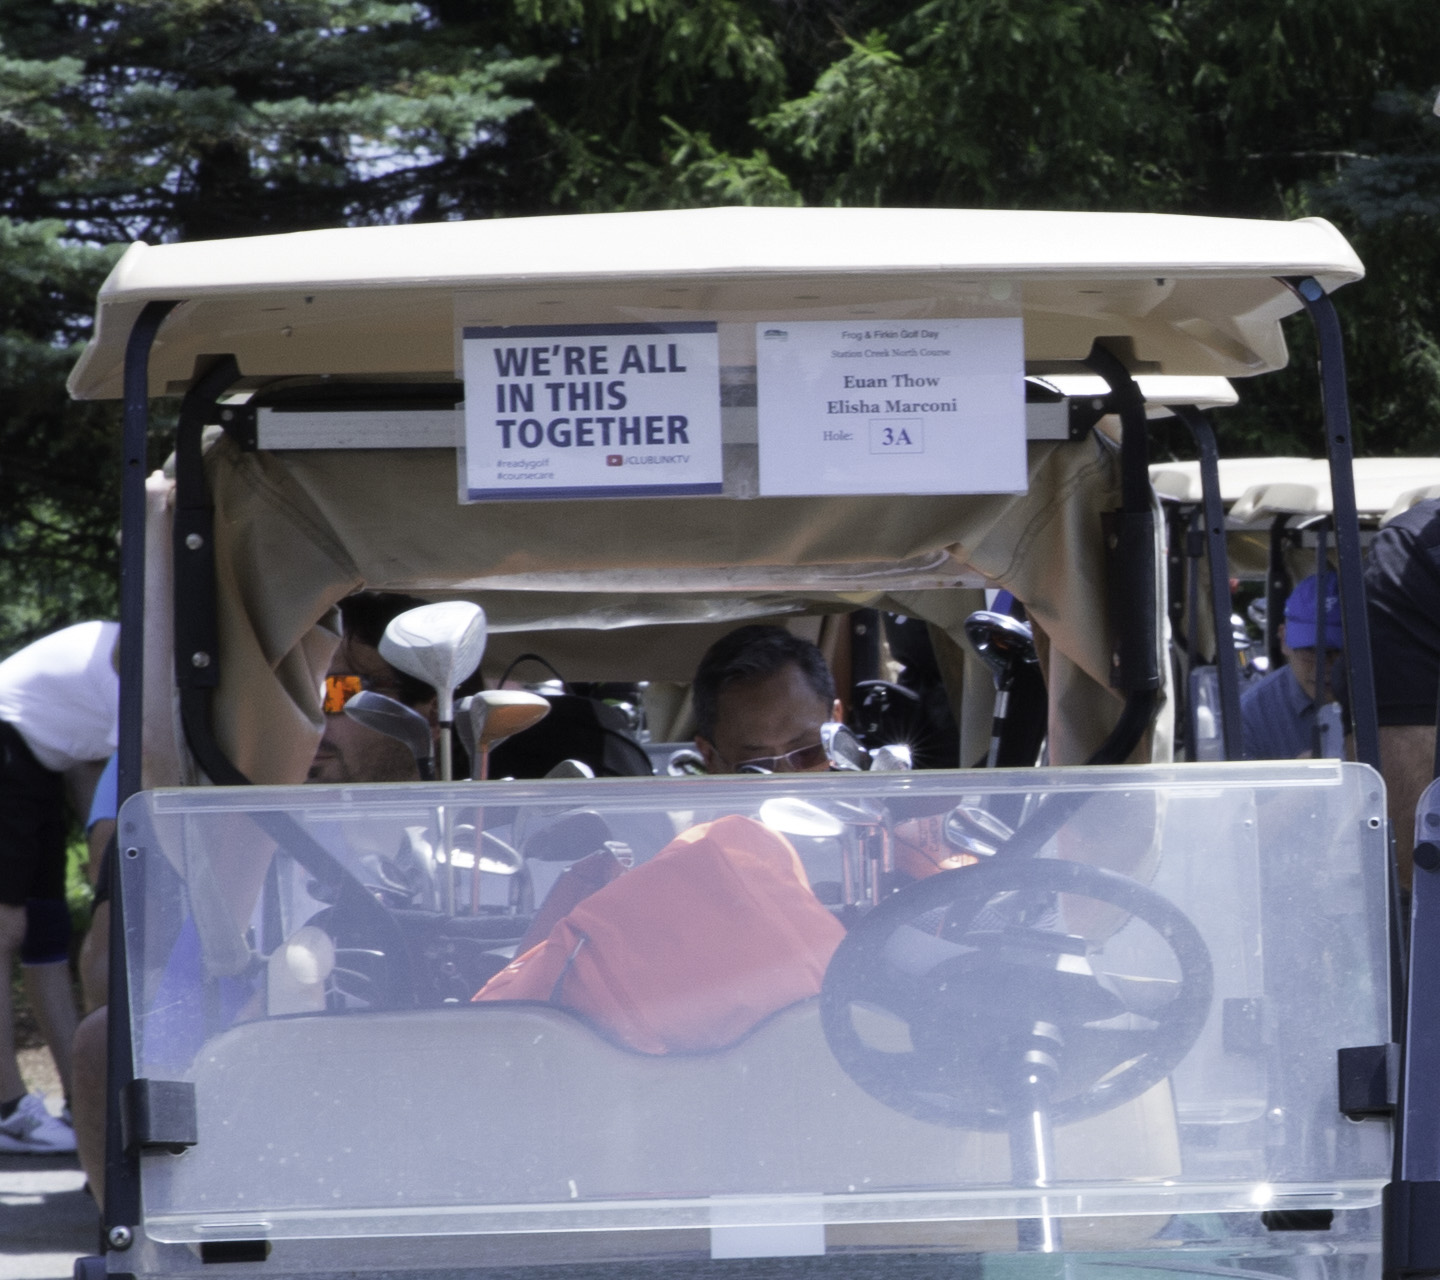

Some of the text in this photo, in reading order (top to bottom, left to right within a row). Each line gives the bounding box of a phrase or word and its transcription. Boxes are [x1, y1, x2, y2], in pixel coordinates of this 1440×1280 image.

[842, 331, 862, 341] Frog
[900, 330, 918, 338] Golf
[921, 330, 939, 340] Day
[494, 344, 687, 377] WE'RE ALL
[843, 374, 940, 389] Euan Thow
[496, 380, 627, 413] IN THIS
[827, 399, 957, 414] Elisha Marconi
[496, 415, 690, 449] TOGETHER
[823, 430, 853, 441] Hole:
[882, 428, 912, 445] 3A
[496, 458, 550, 469] #readygolf
[496, 471, 555, 481] #coursecare
